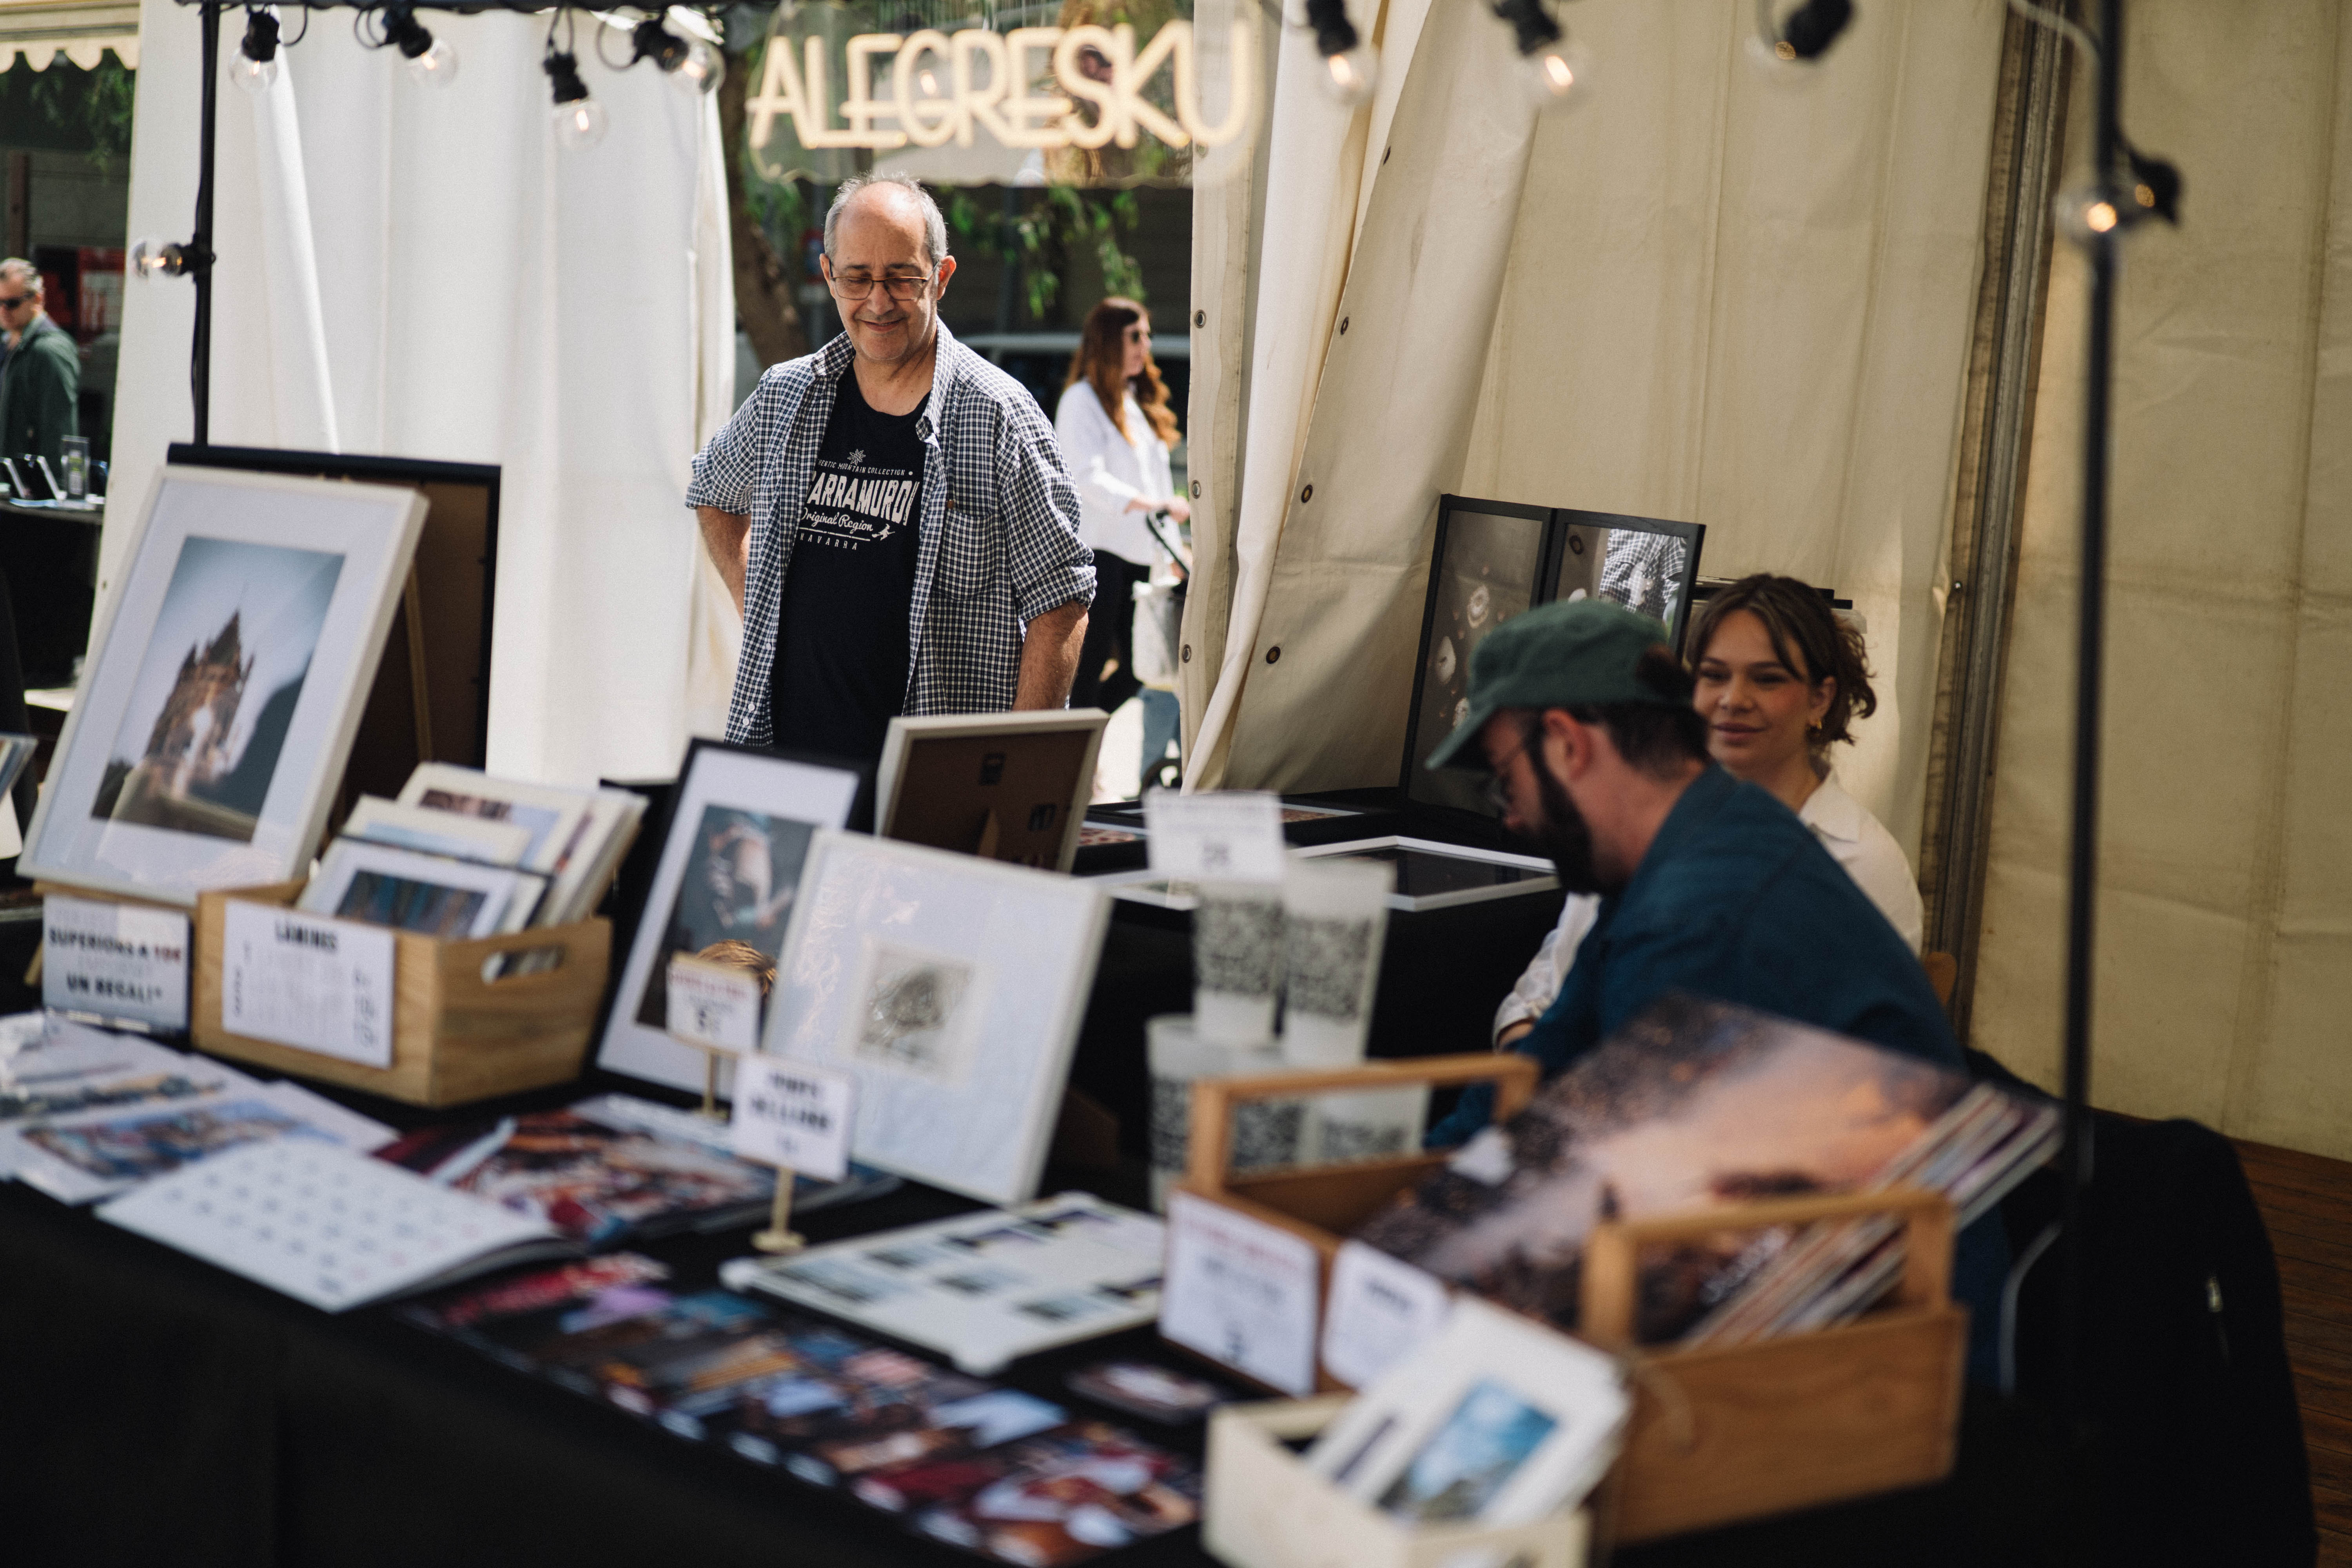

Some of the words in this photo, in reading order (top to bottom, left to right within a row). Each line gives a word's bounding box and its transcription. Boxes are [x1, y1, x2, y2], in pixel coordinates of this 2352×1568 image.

[744, 20, 1254, 149] ALEGRESKU
[818, 459, 837, 468] HENTIC
[838, 463, 866, 474] MOUNTAIN
[867, 466, 906, 476] COLLECTION
[806, 471, 920, 526] ARRAMURDI
[838, 514, 873, 534] Region
[800, 532, 857, 550] NAVARRA
[66, 972, 90, 993] UN
